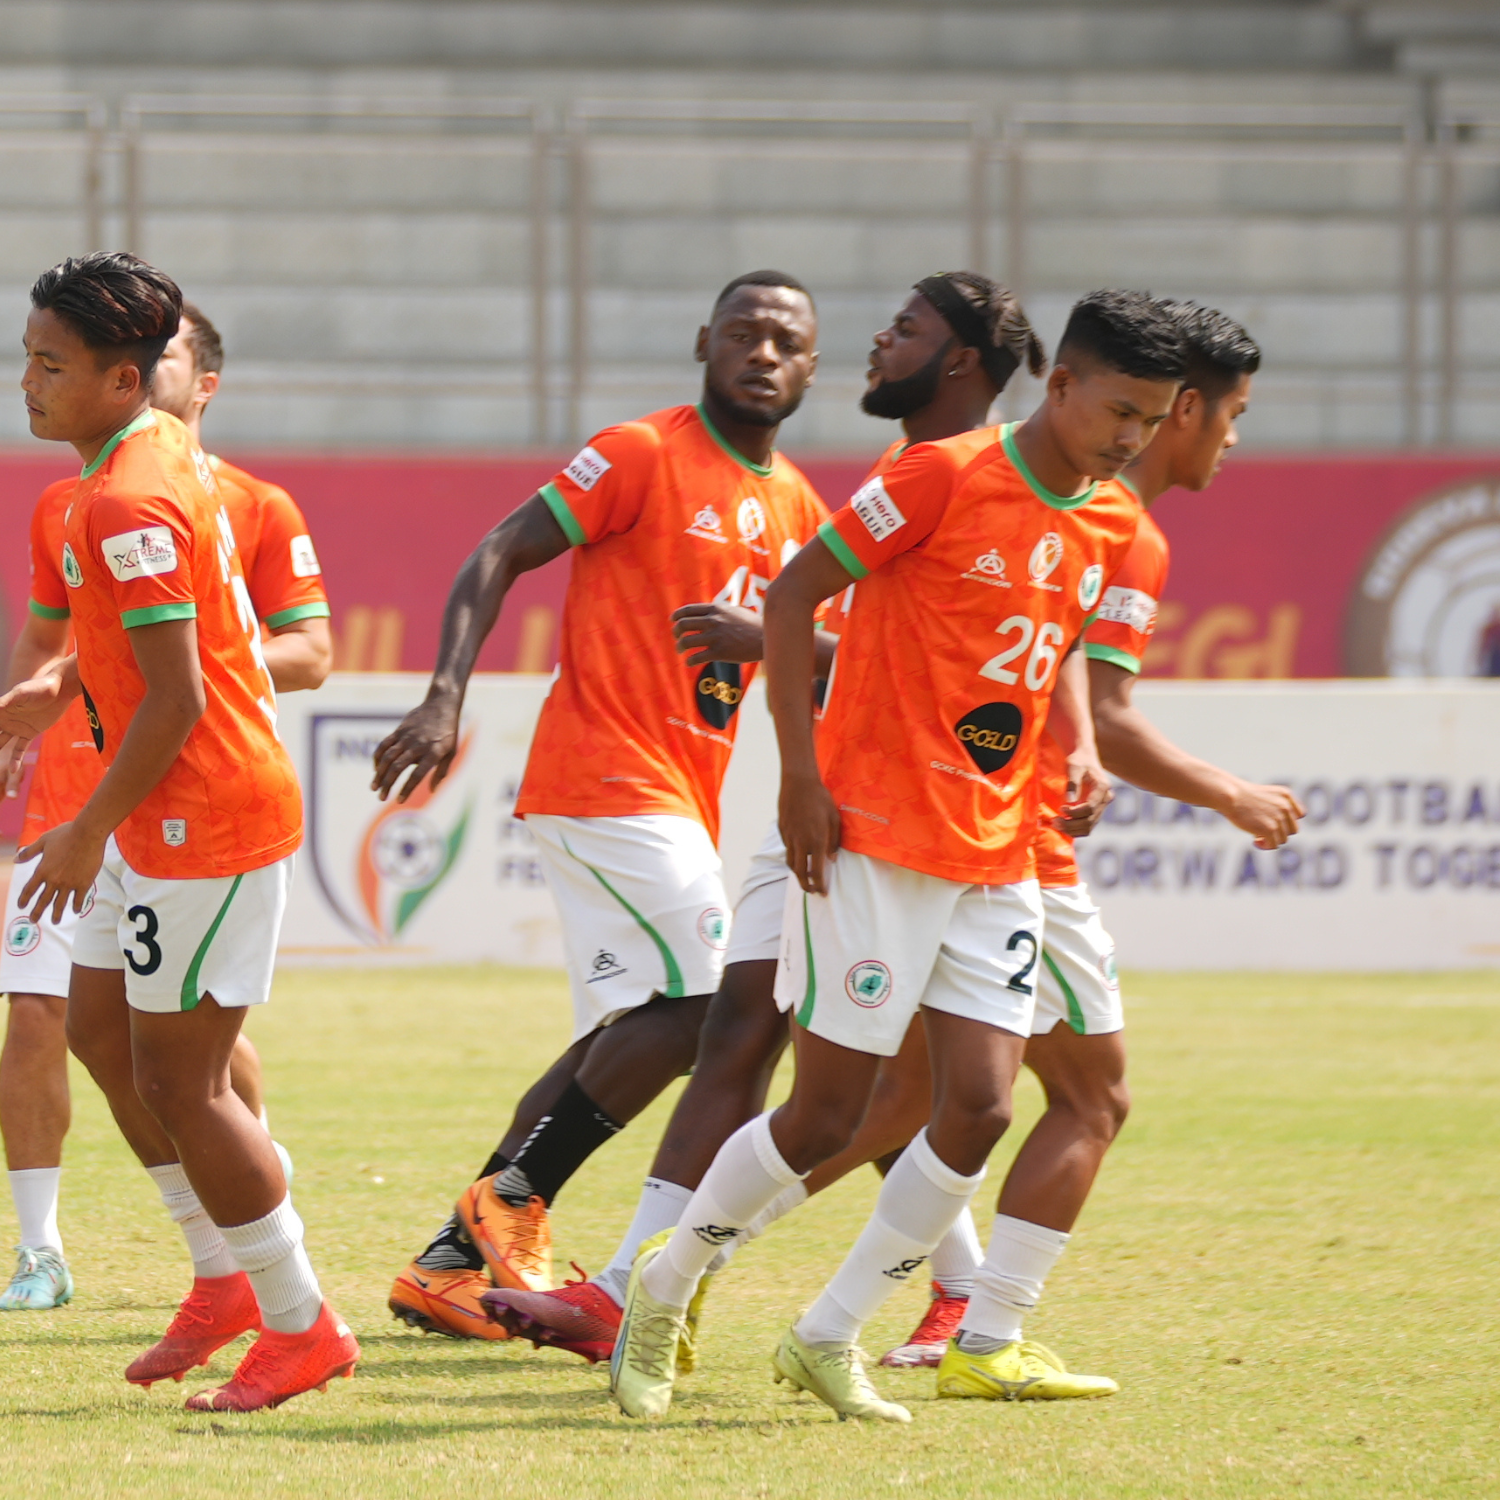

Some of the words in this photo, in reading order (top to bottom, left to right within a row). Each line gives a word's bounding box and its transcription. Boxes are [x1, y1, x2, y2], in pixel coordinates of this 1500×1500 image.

[870, 495, 896, 528] Hero
[977, 614, 1064, 691] 26
[123, 904, 162, 976] 3
[1006, 930, 1037, 995] 2
